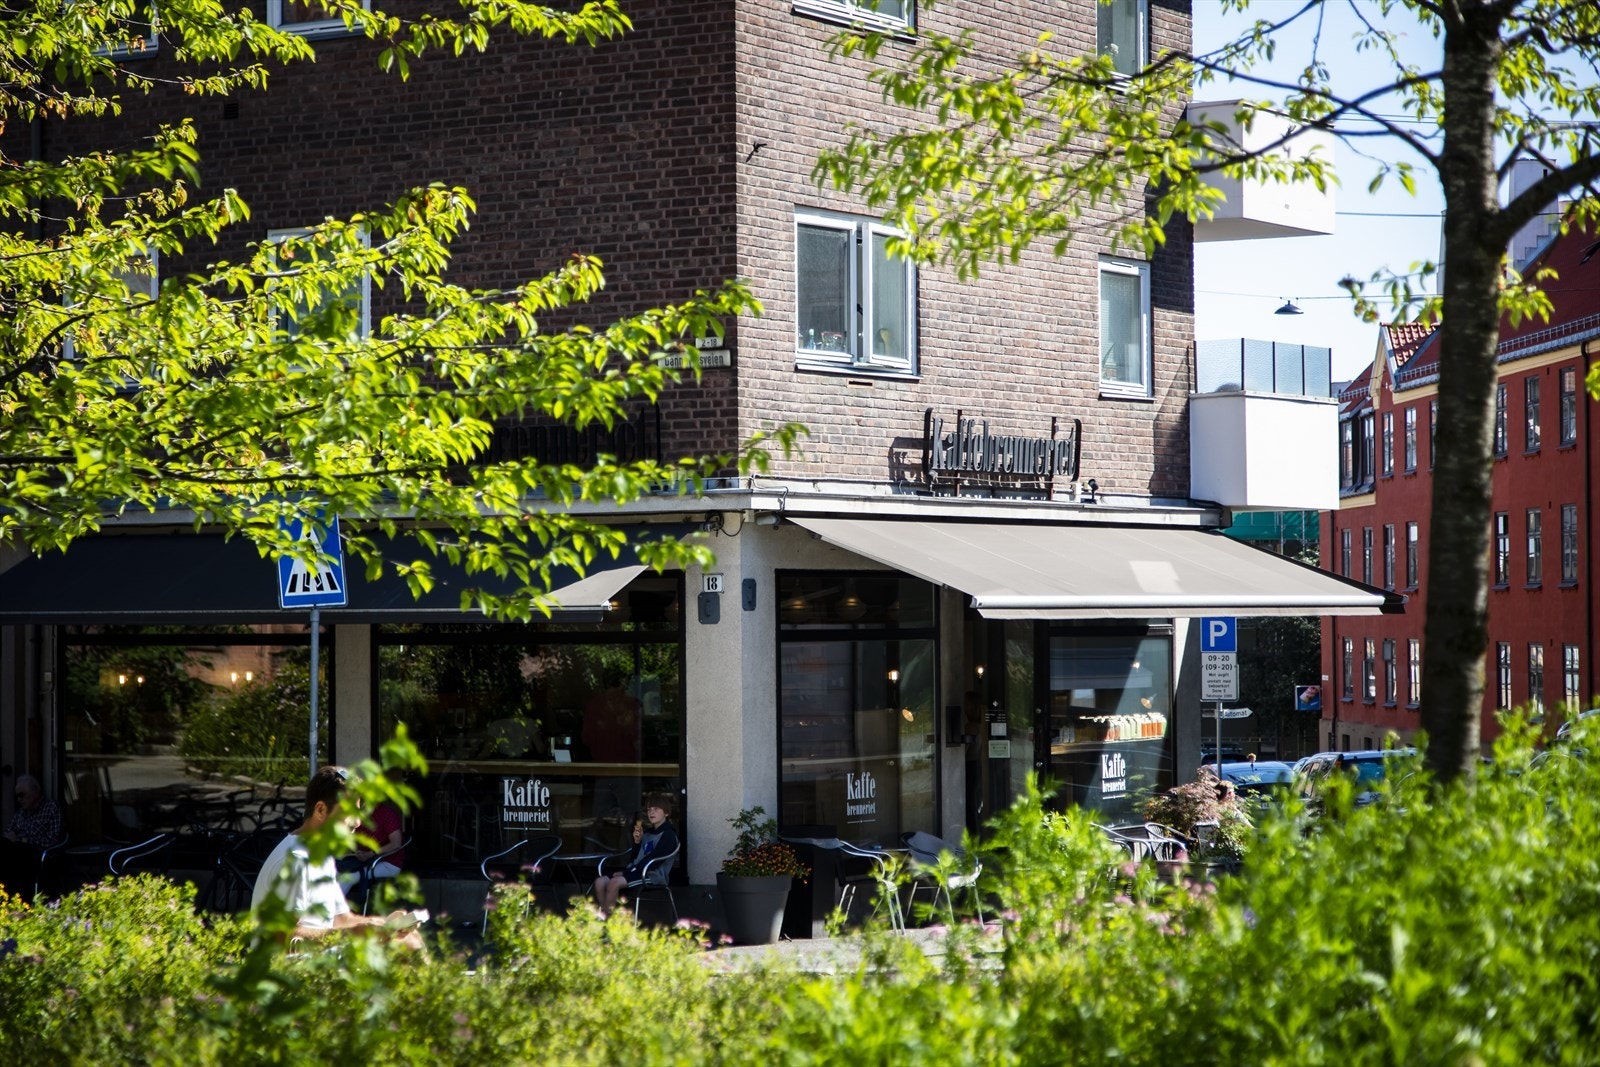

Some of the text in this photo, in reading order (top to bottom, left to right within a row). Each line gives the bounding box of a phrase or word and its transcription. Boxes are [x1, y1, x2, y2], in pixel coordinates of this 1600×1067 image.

[931, 417, 1077, 477] Kaffebrenneriet
[706, 576, 718, 591] 18
[1209, 620, 1228, 648] P
[1101, 753, 1126, 779] Kaffe
[503, 779, 550, 807] Kaffe
[846, 771, 876, 800] Kaffe
[503, 808, 550, 823] brenneriet
